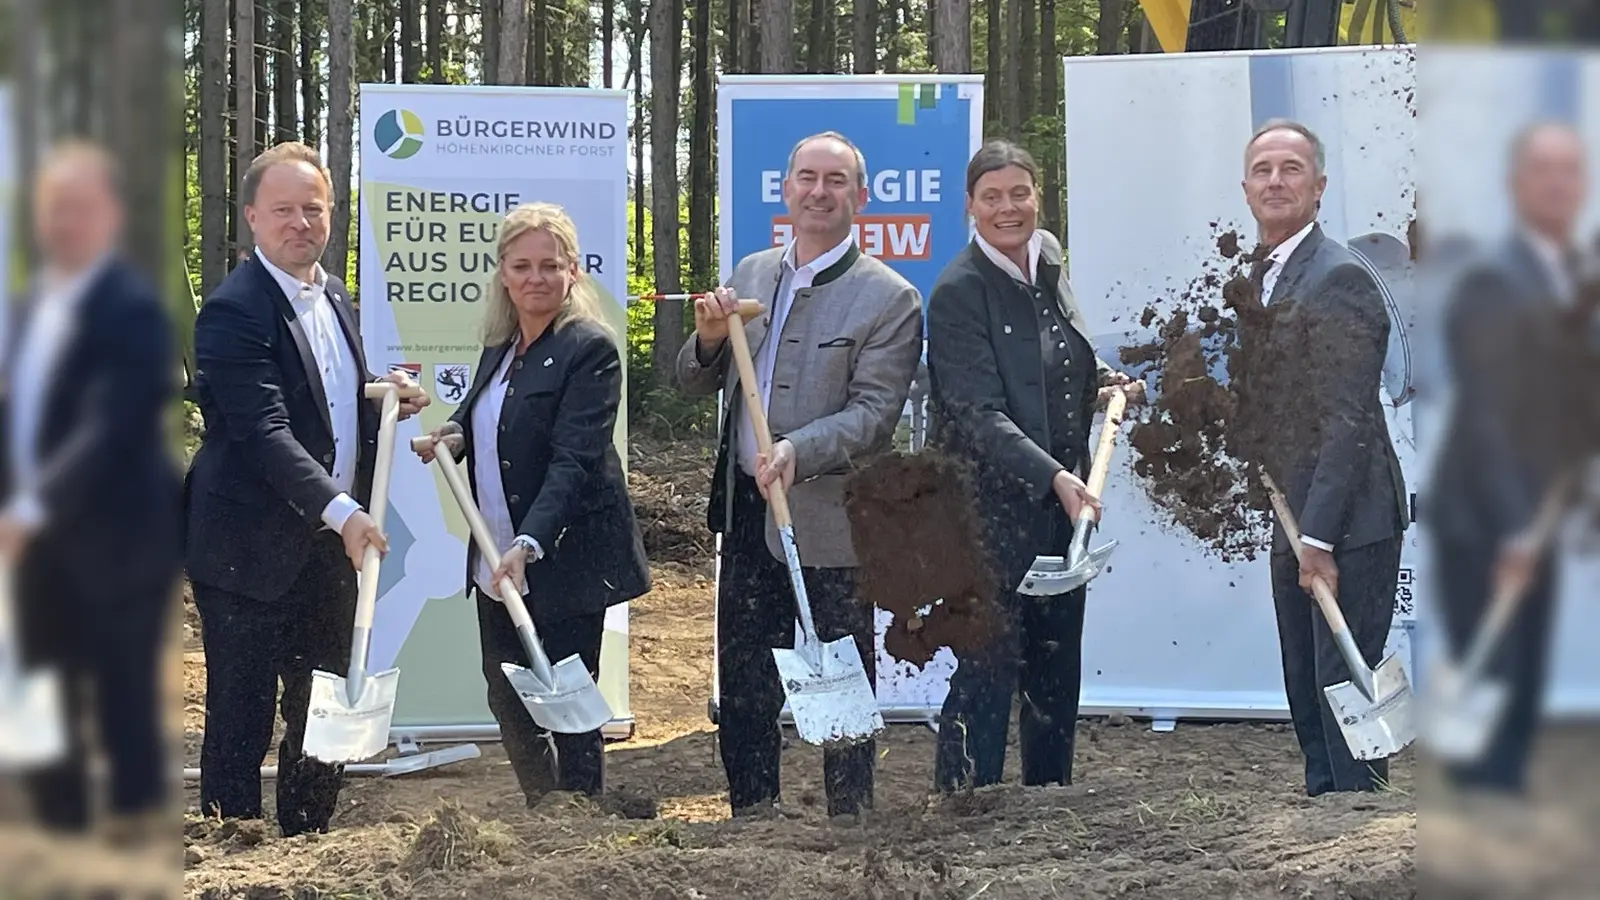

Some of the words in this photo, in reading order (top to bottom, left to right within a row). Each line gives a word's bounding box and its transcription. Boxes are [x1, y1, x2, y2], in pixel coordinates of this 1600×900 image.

[436, 115, 616, 140] BÜRGERWIND
[570, 145, 615, 157] FORST
[761, 169, 941, 203] EGIE
[386, 191, 520, 213] ENERGIE
[386, 217, 446, 243] FÜR
[459, 222, 498, 243] EU
[385, 252, 447, 273] AUS
[386, 282, 490, 303] REGIO
[386, 343, 483, 353] www.buergerwind-
